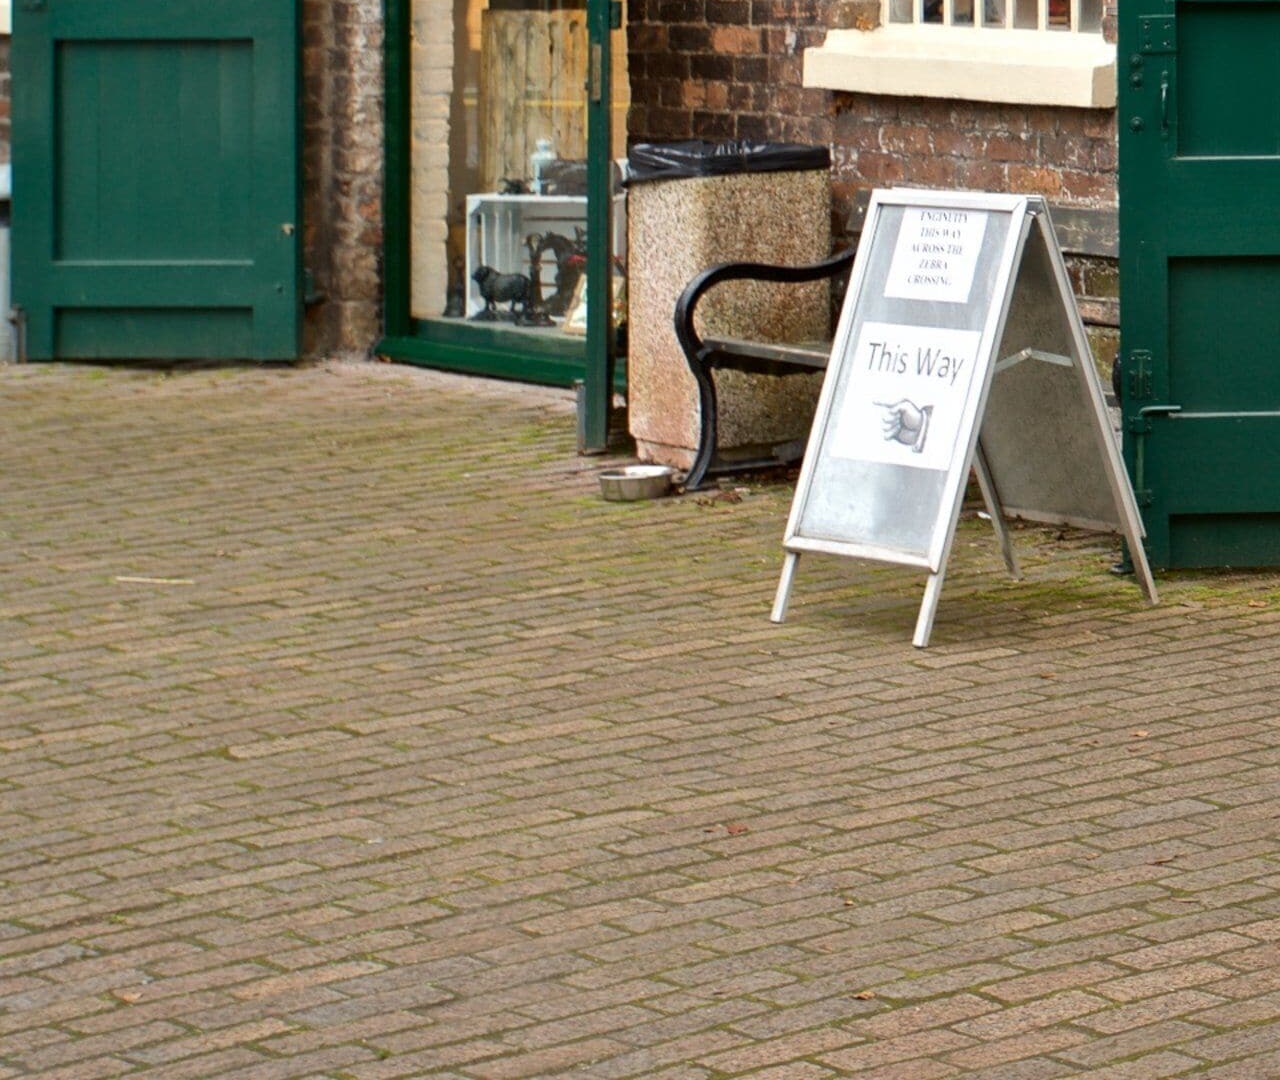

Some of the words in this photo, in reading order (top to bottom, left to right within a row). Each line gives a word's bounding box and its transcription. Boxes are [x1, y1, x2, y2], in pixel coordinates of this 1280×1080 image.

[920, 227, 940, 238] THIS
[912, 243, 945, 254] ACROSS
[946, 244, 963, 255] THE
[867, 341, 908, 375] This
[917, 347, 964, 386] Way
